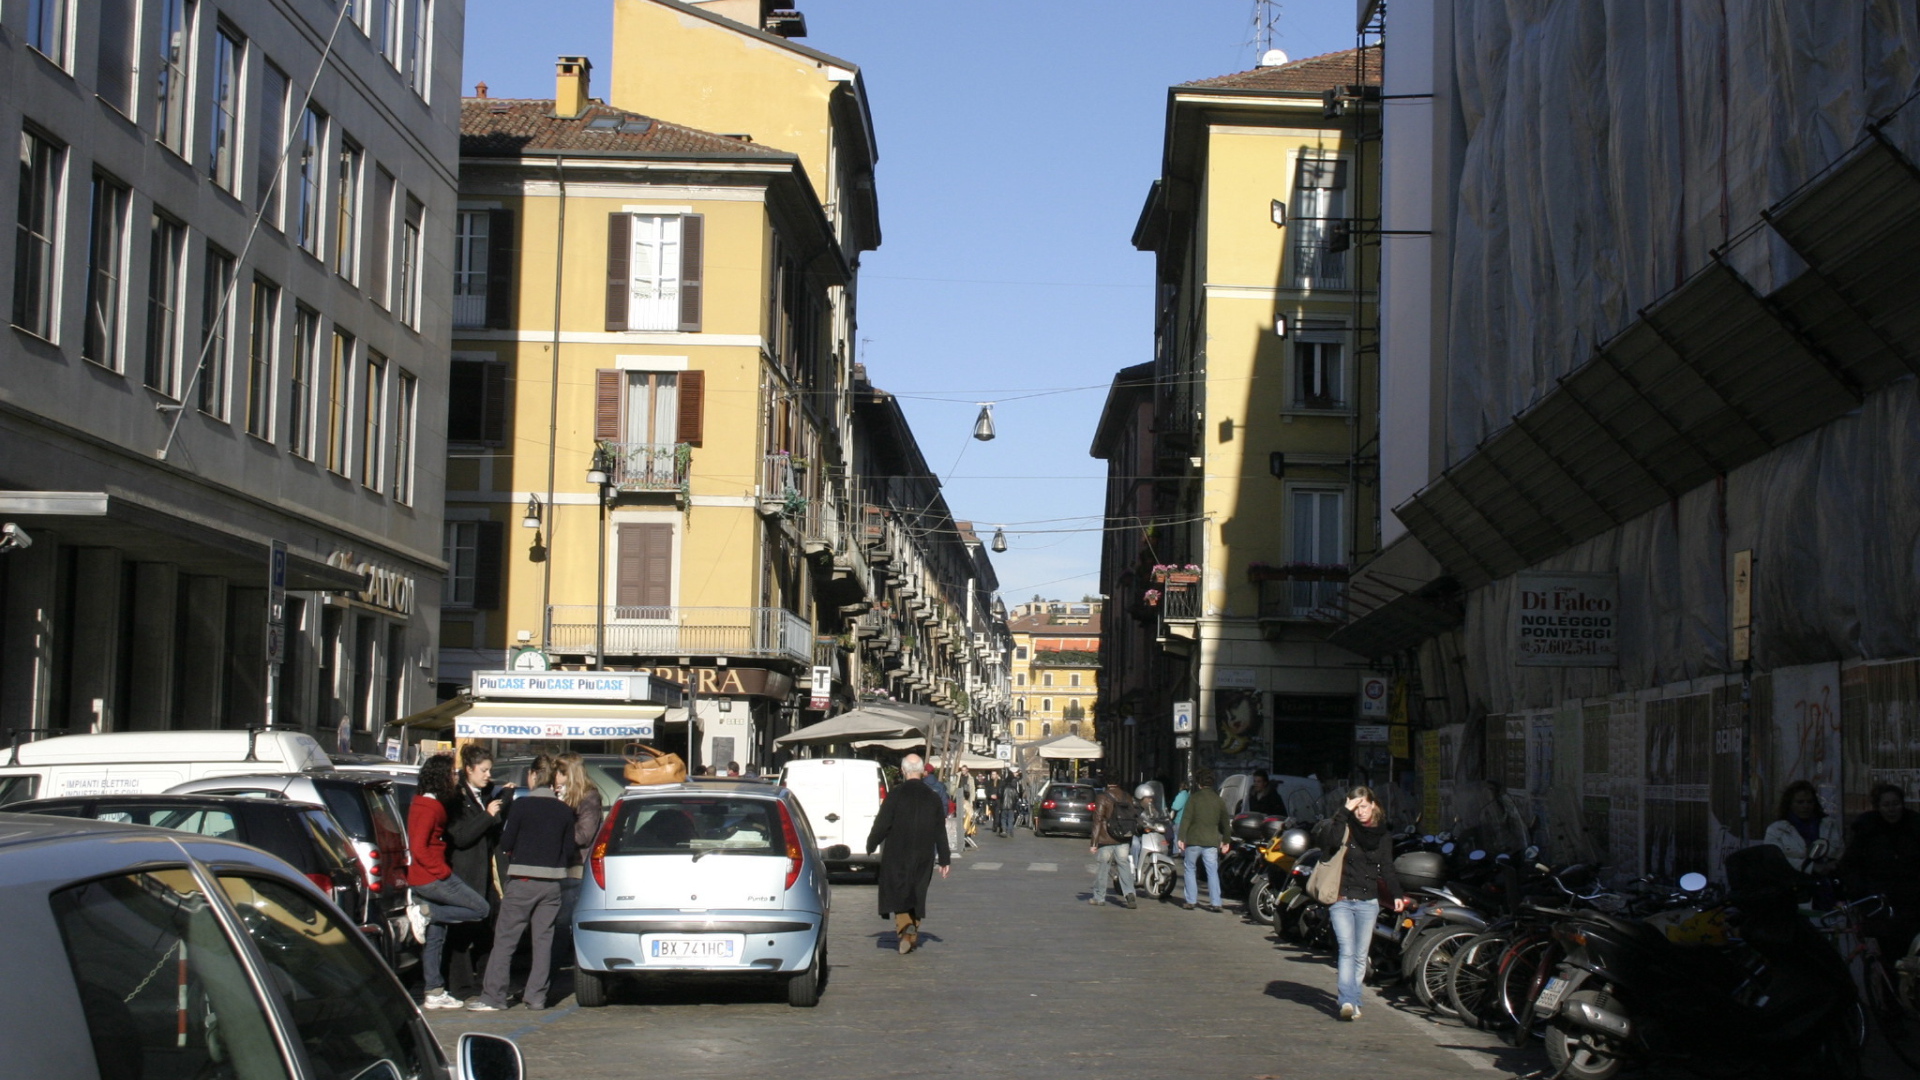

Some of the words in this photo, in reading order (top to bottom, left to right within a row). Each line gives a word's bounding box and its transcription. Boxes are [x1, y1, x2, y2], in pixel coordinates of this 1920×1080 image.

[1522, 591, 1547, 610] Di
[1553, 592, 1611, 612] Falco
[1521, 615, 1611, 627] NOLEGGIO
[1521, 628, 1611, 639] PONTEGGI
[457, 724, 475, 734] IL
[479, 724, 542, 735] GIORNO
[567, 726, 585, 735] IL
[588, 726, 652, 736] GIORNO
[66, 779, 99, 788] IMPIANTI
[101, 779, 139, 788] ELETTRICI
[661, 942, 677, 956] BX
[682, 941, 725, 956] 741HC
